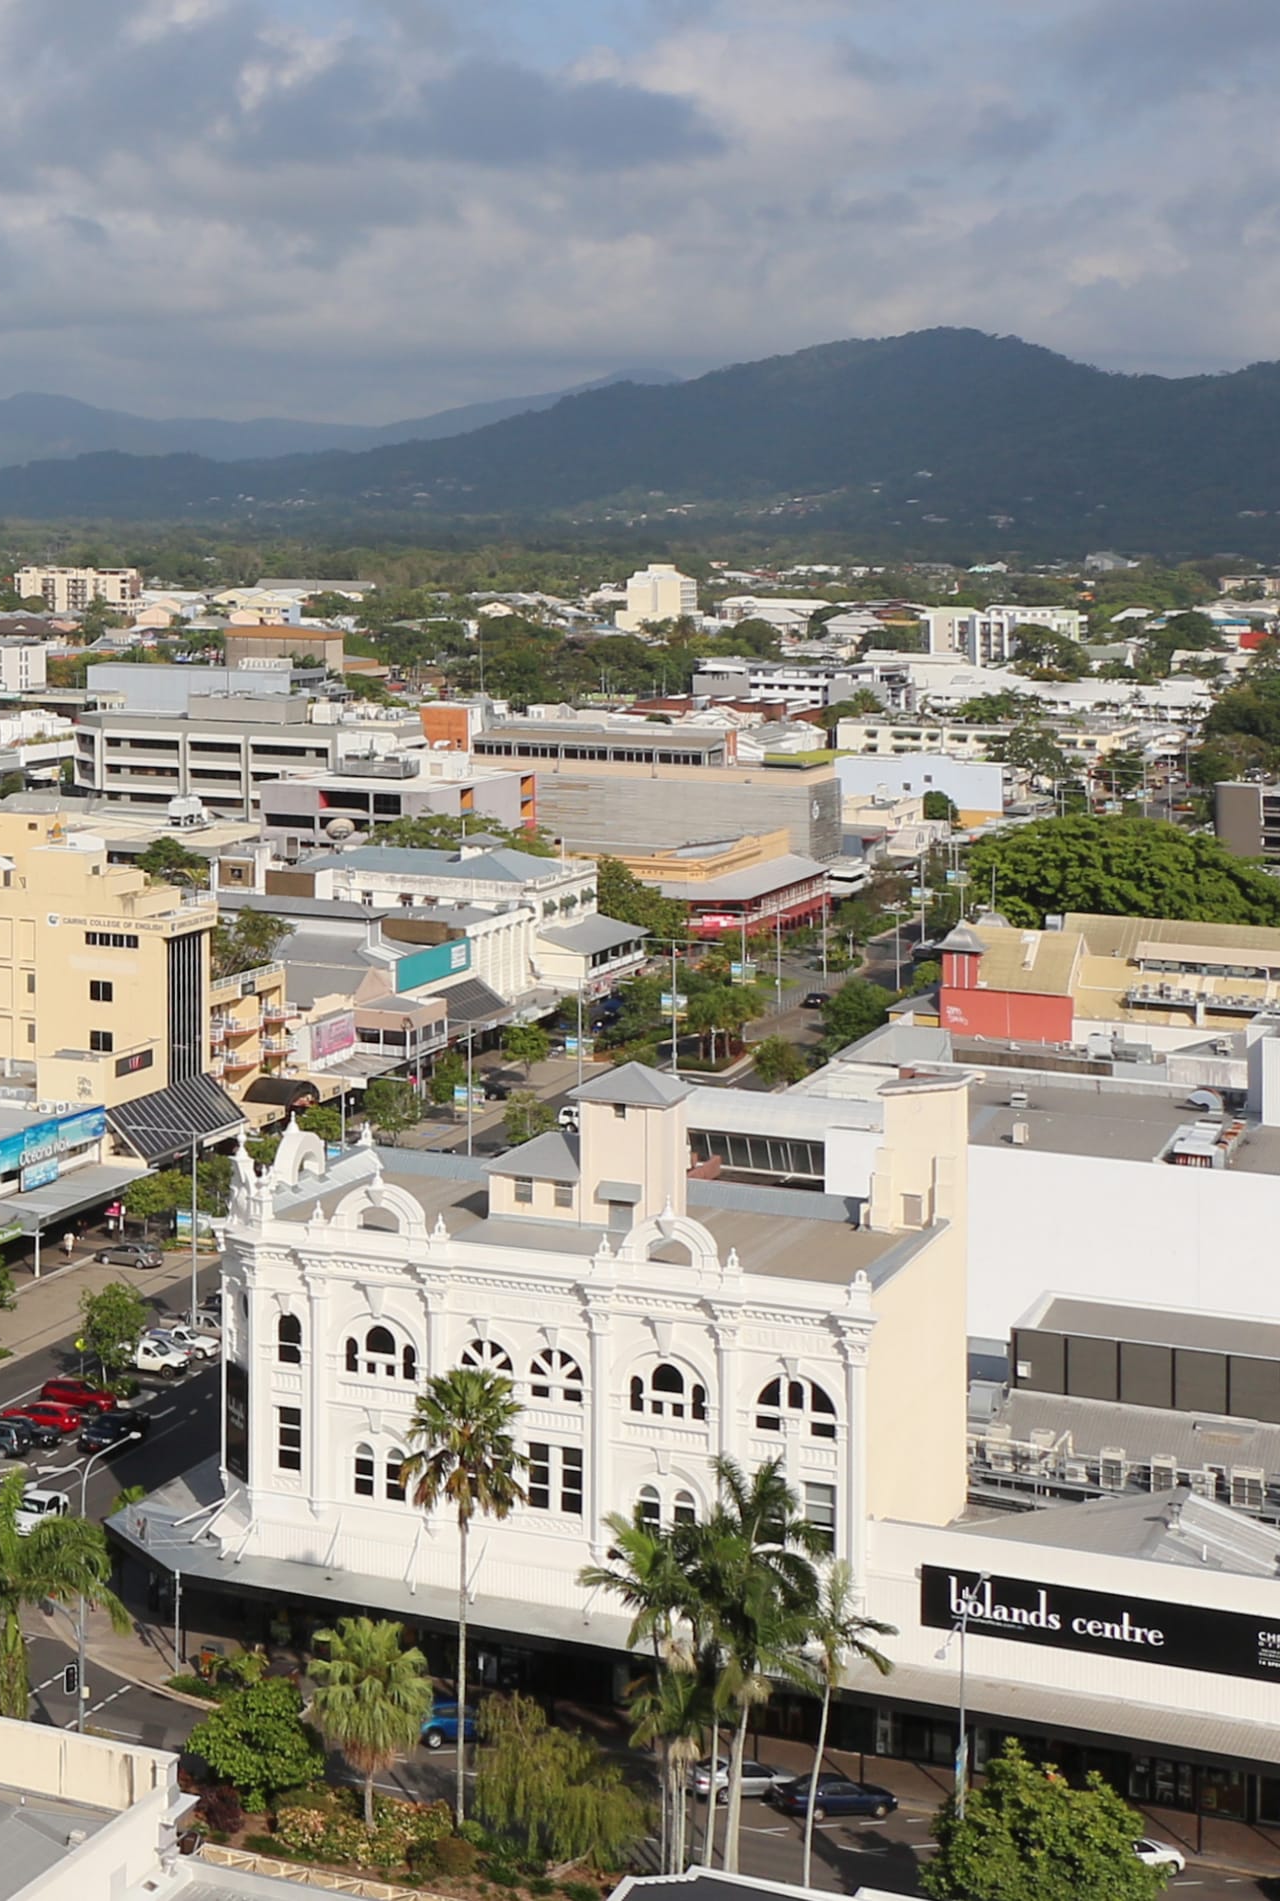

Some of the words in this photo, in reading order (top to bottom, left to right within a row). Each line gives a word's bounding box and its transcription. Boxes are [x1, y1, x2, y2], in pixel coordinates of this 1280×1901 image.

[63, 916, 88, 926] CAIRNS
[90, 919, 121, 929] COLLEGE
[135, 923, 164, 931] ENGLISH
[948, 1575, 1062, 1630] bolands
[1071, 1611, 1165, 1647] centre
